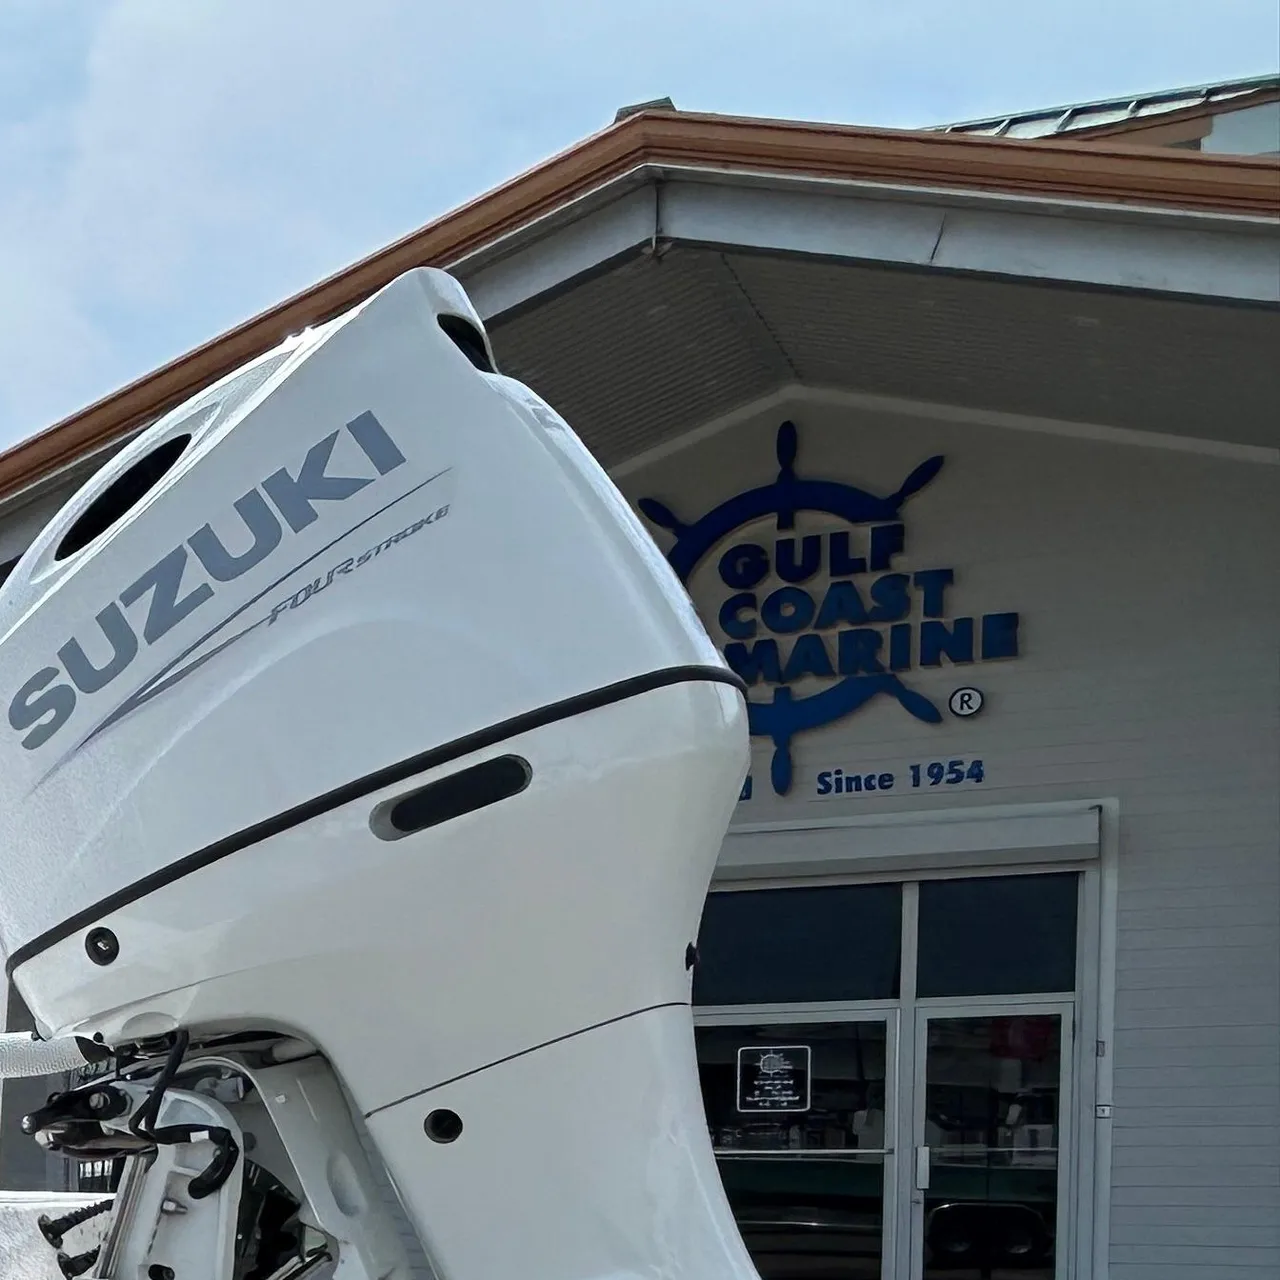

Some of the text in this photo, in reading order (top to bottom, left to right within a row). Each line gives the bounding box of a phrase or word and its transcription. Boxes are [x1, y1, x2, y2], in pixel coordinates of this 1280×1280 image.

[8, 409, 407, 751] SUZUKI
[718, 523, 905, 589] GULF
[268, 557, 355, 626] FOUR
[718, 568, 954, 640] COAST
[723, 612, 1019, 685] MARINE
[816, 759, 985, 795] Since 1954
